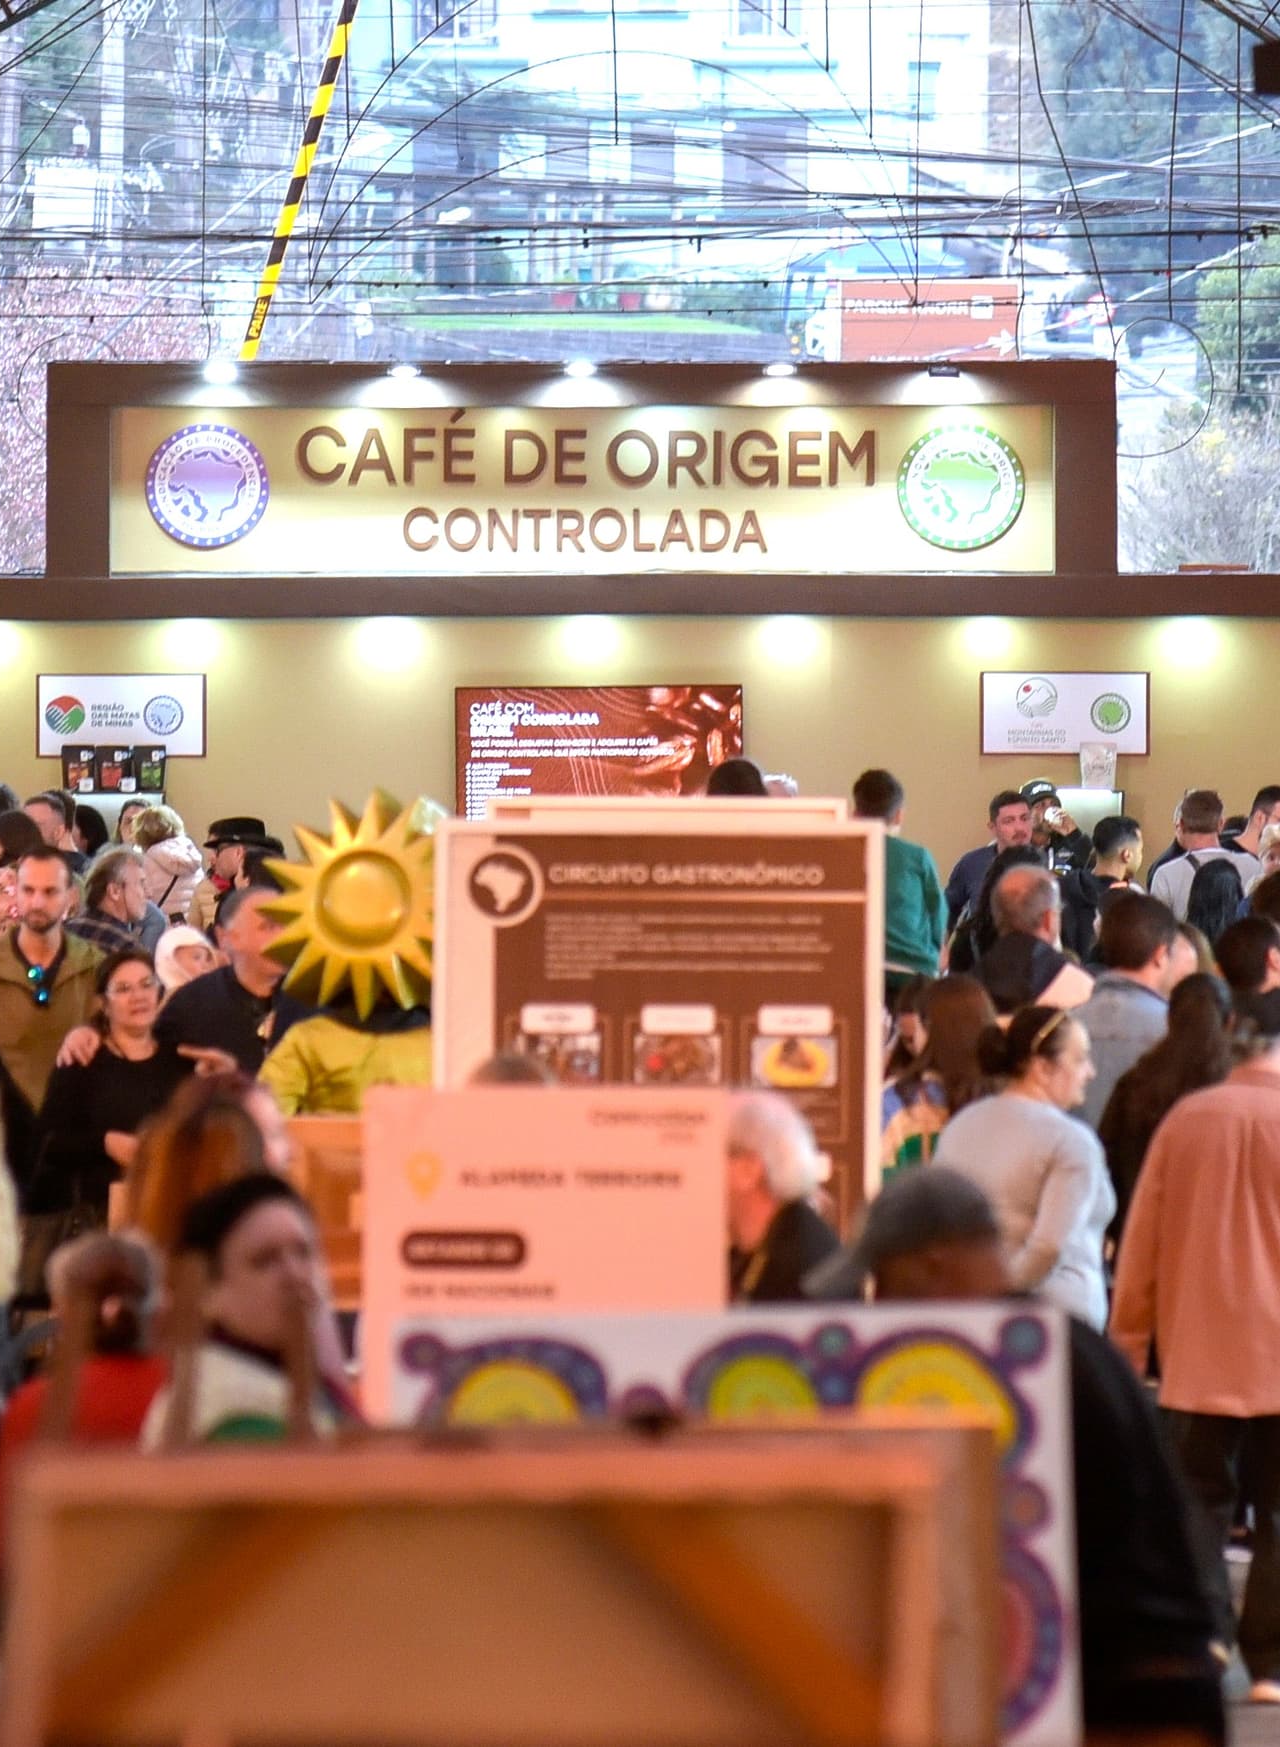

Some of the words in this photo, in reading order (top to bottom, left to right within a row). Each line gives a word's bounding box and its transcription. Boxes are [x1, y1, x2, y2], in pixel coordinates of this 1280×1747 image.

[295, 407, 477, 488] CAFÉ
[503, 428, 588, 487] DE
[605, 428, 877, 489] ORIGEM
[402, 506, 769, 555] CONTROLADA
[504, 702, 535, 715] COM
[548, 863, 650, 885] CIRCUITO
